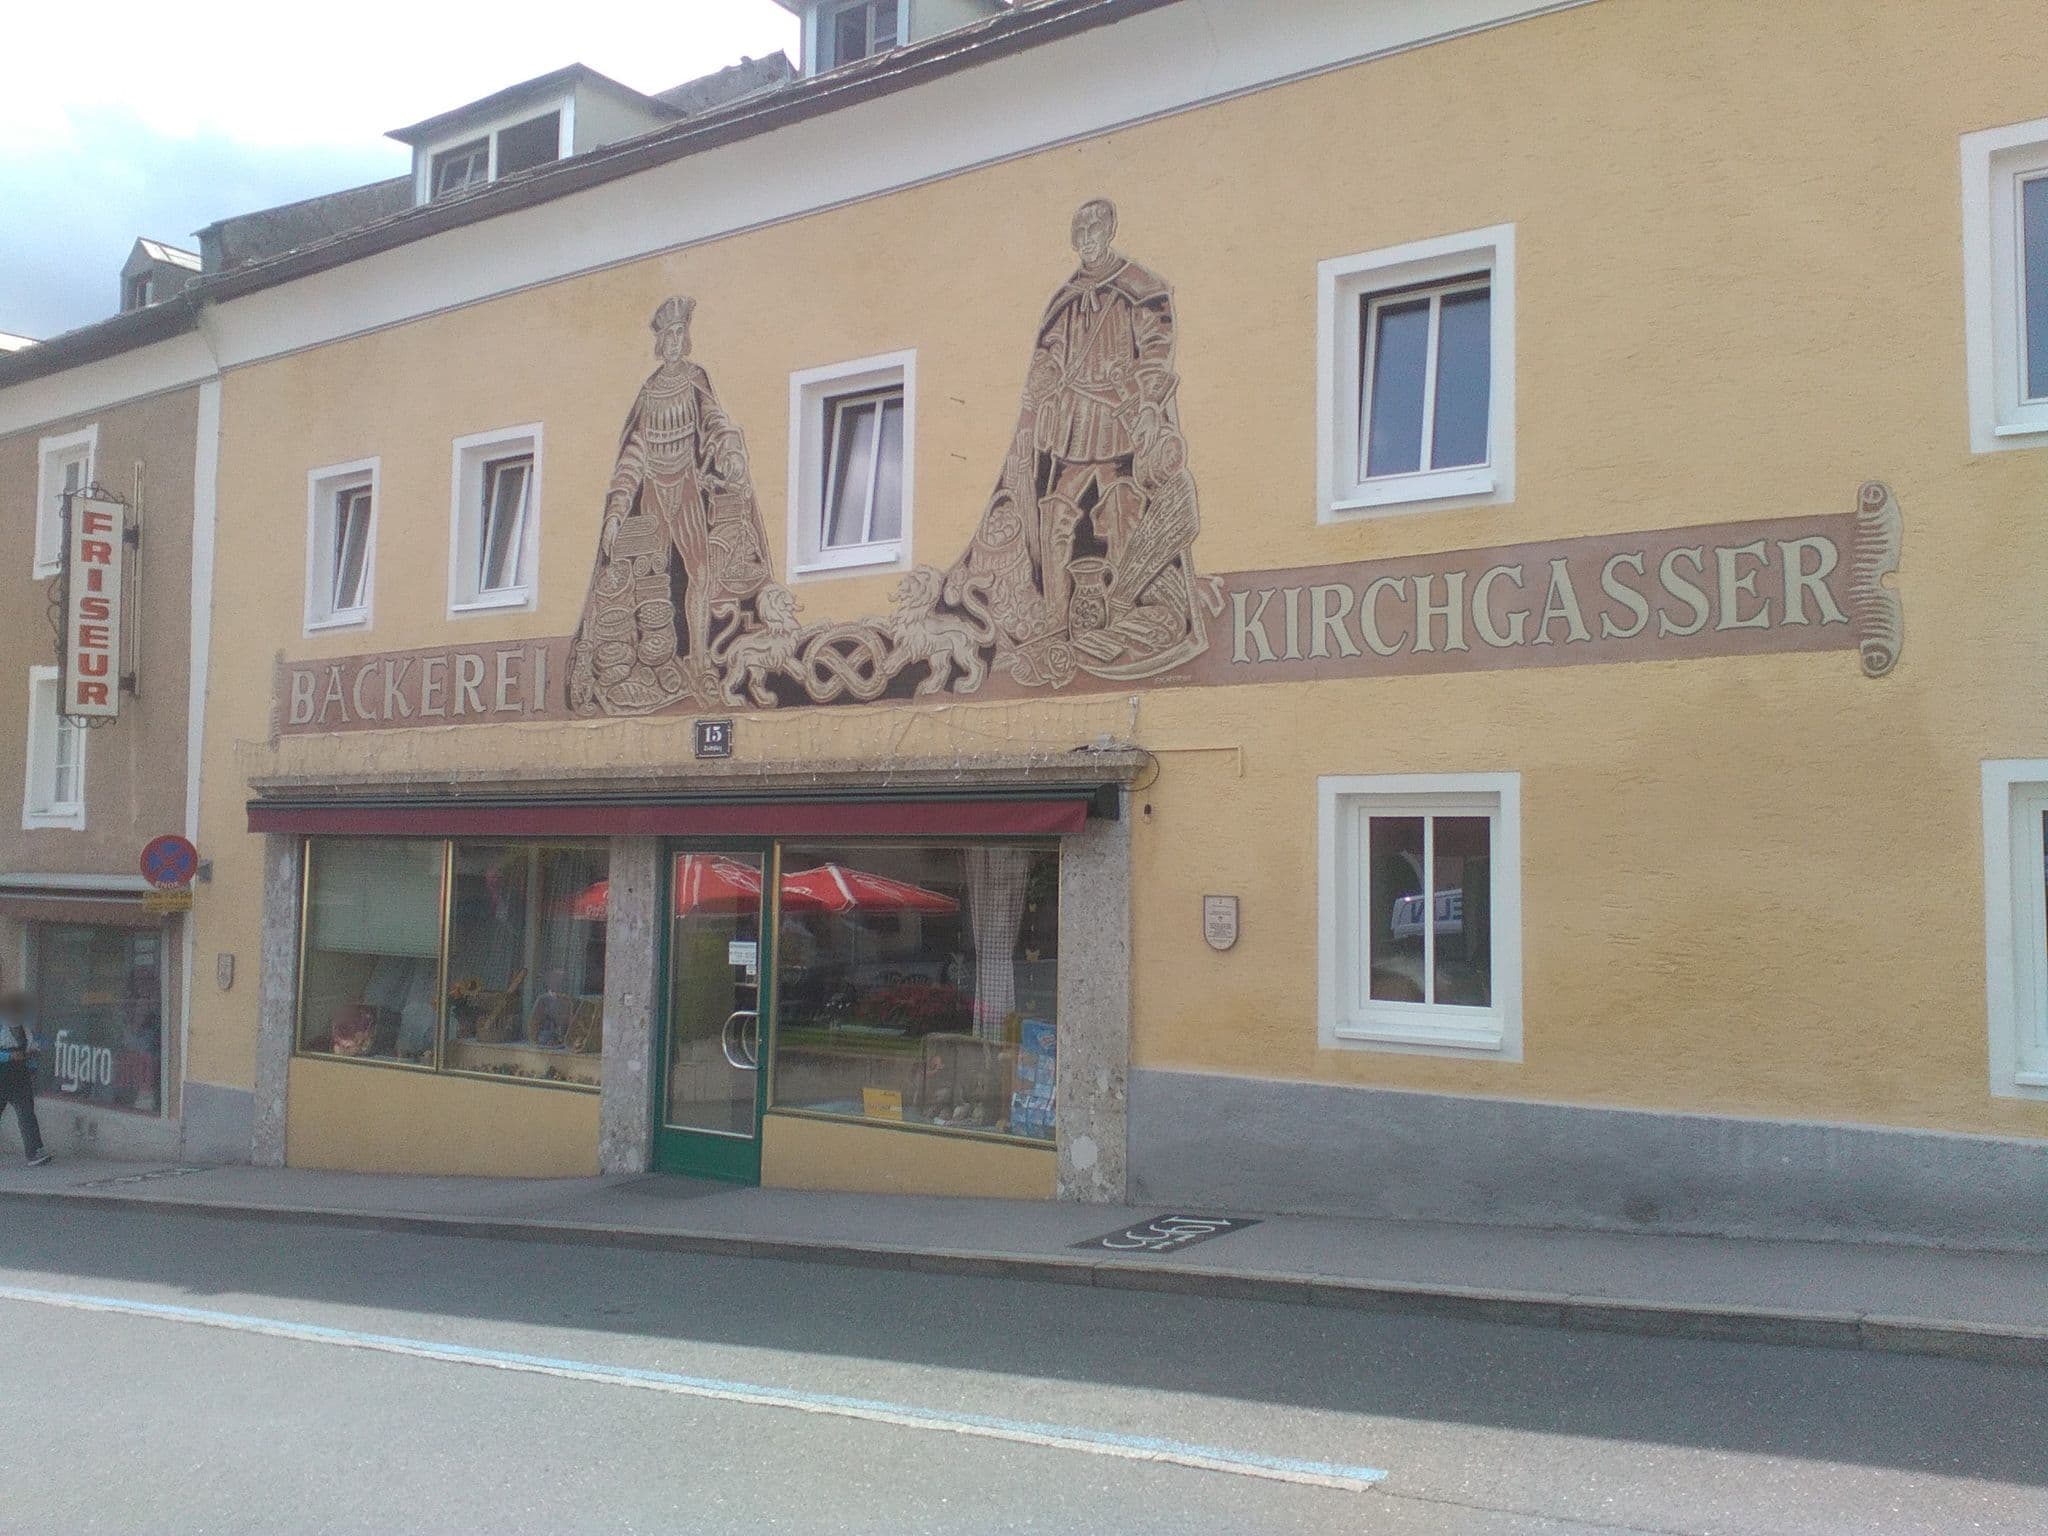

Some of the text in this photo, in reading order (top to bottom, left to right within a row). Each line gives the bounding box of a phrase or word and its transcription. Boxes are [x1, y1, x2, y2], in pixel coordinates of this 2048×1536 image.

[76, 511, 113, 706] FRISEUR
[288, 535, 1852, 726] BÄCKEREI KIRCHGASSER
[705, 726, 722, 743] 15
[54, 1029, 111, 1093] figaro
